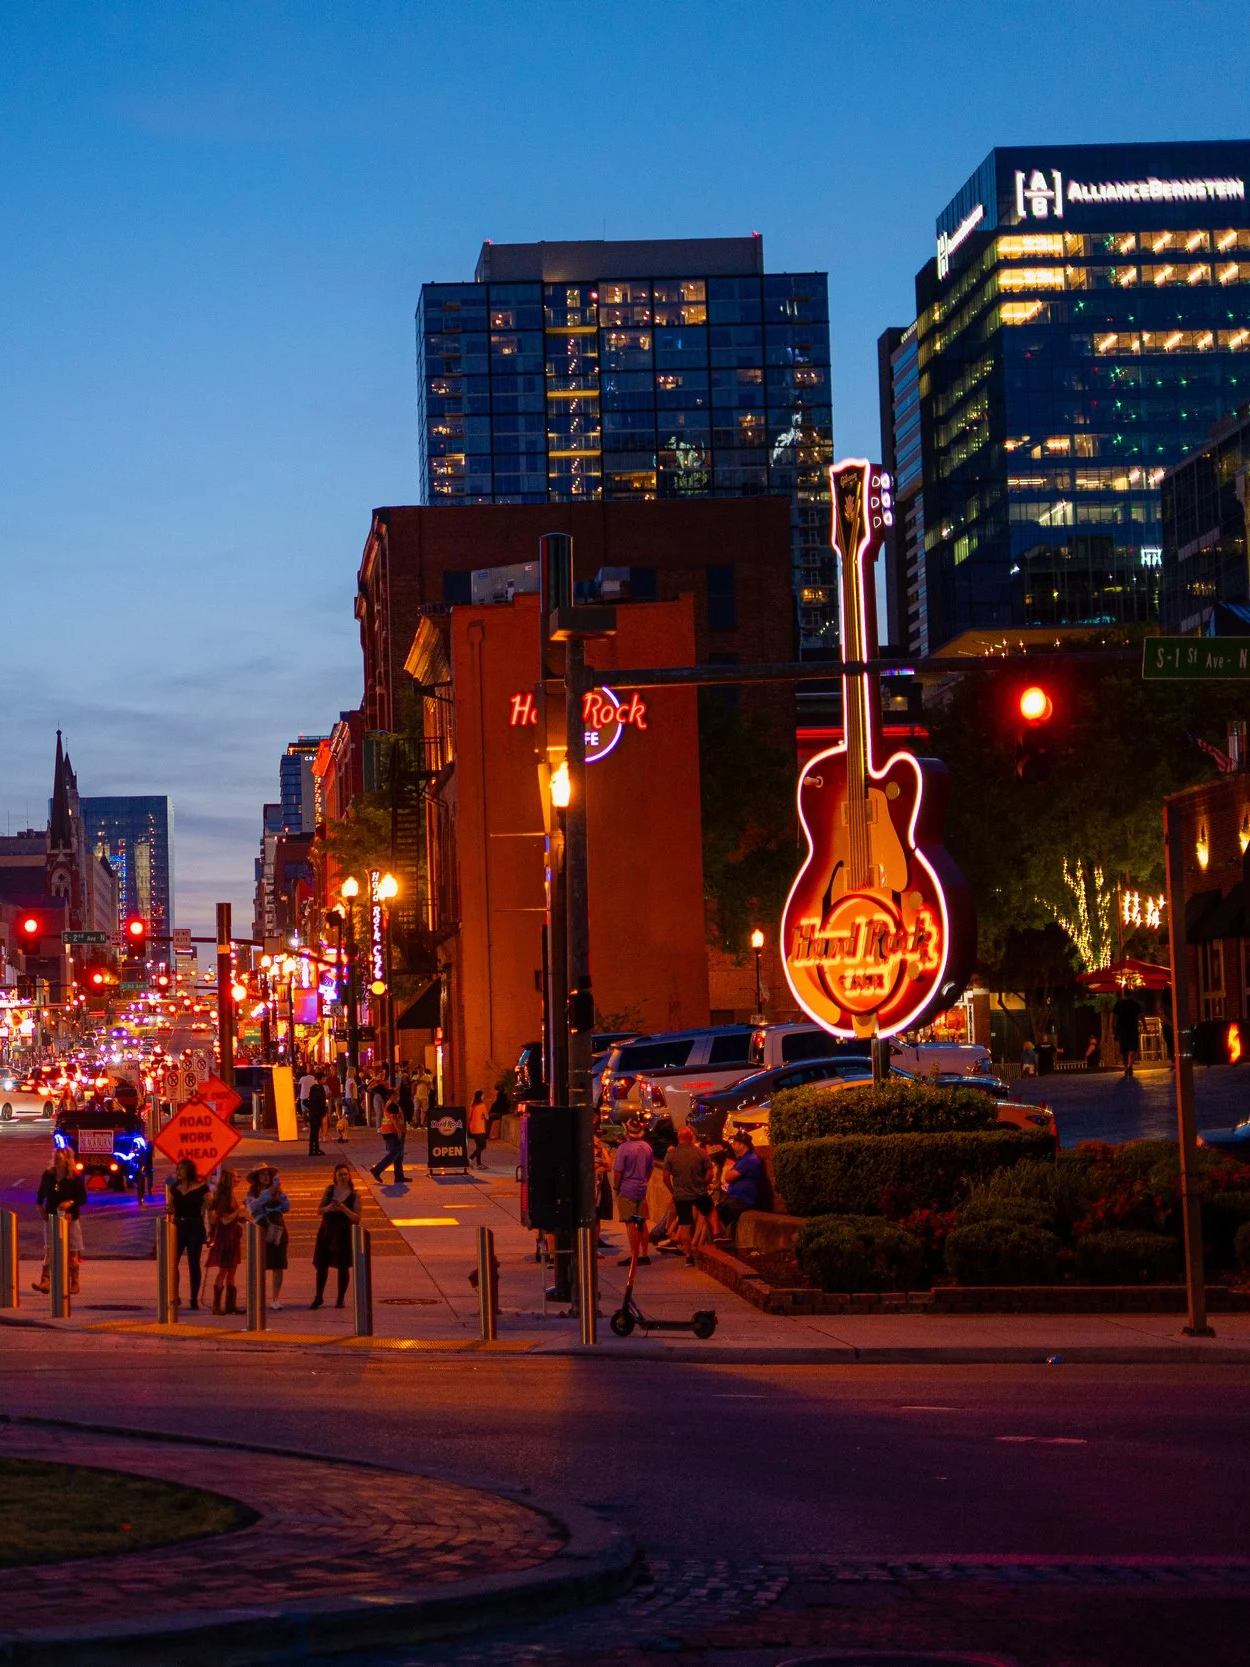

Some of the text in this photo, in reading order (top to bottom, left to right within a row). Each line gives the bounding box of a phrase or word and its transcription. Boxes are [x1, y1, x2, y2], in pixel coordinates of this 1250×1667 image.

[1239, 648, 1248, 669] N
[583, 692, 648, 729] Rock
[372, 906, 381, 942] Rock
[372, 945, 382, 979] Cafe
[180, 1115, 212, 1127] ROAD
[180, 1131, 212, 1143] WORK
[177, 1147, 218, 1159] AHEAD
[432, 1146, 463, 1157] OPEN
